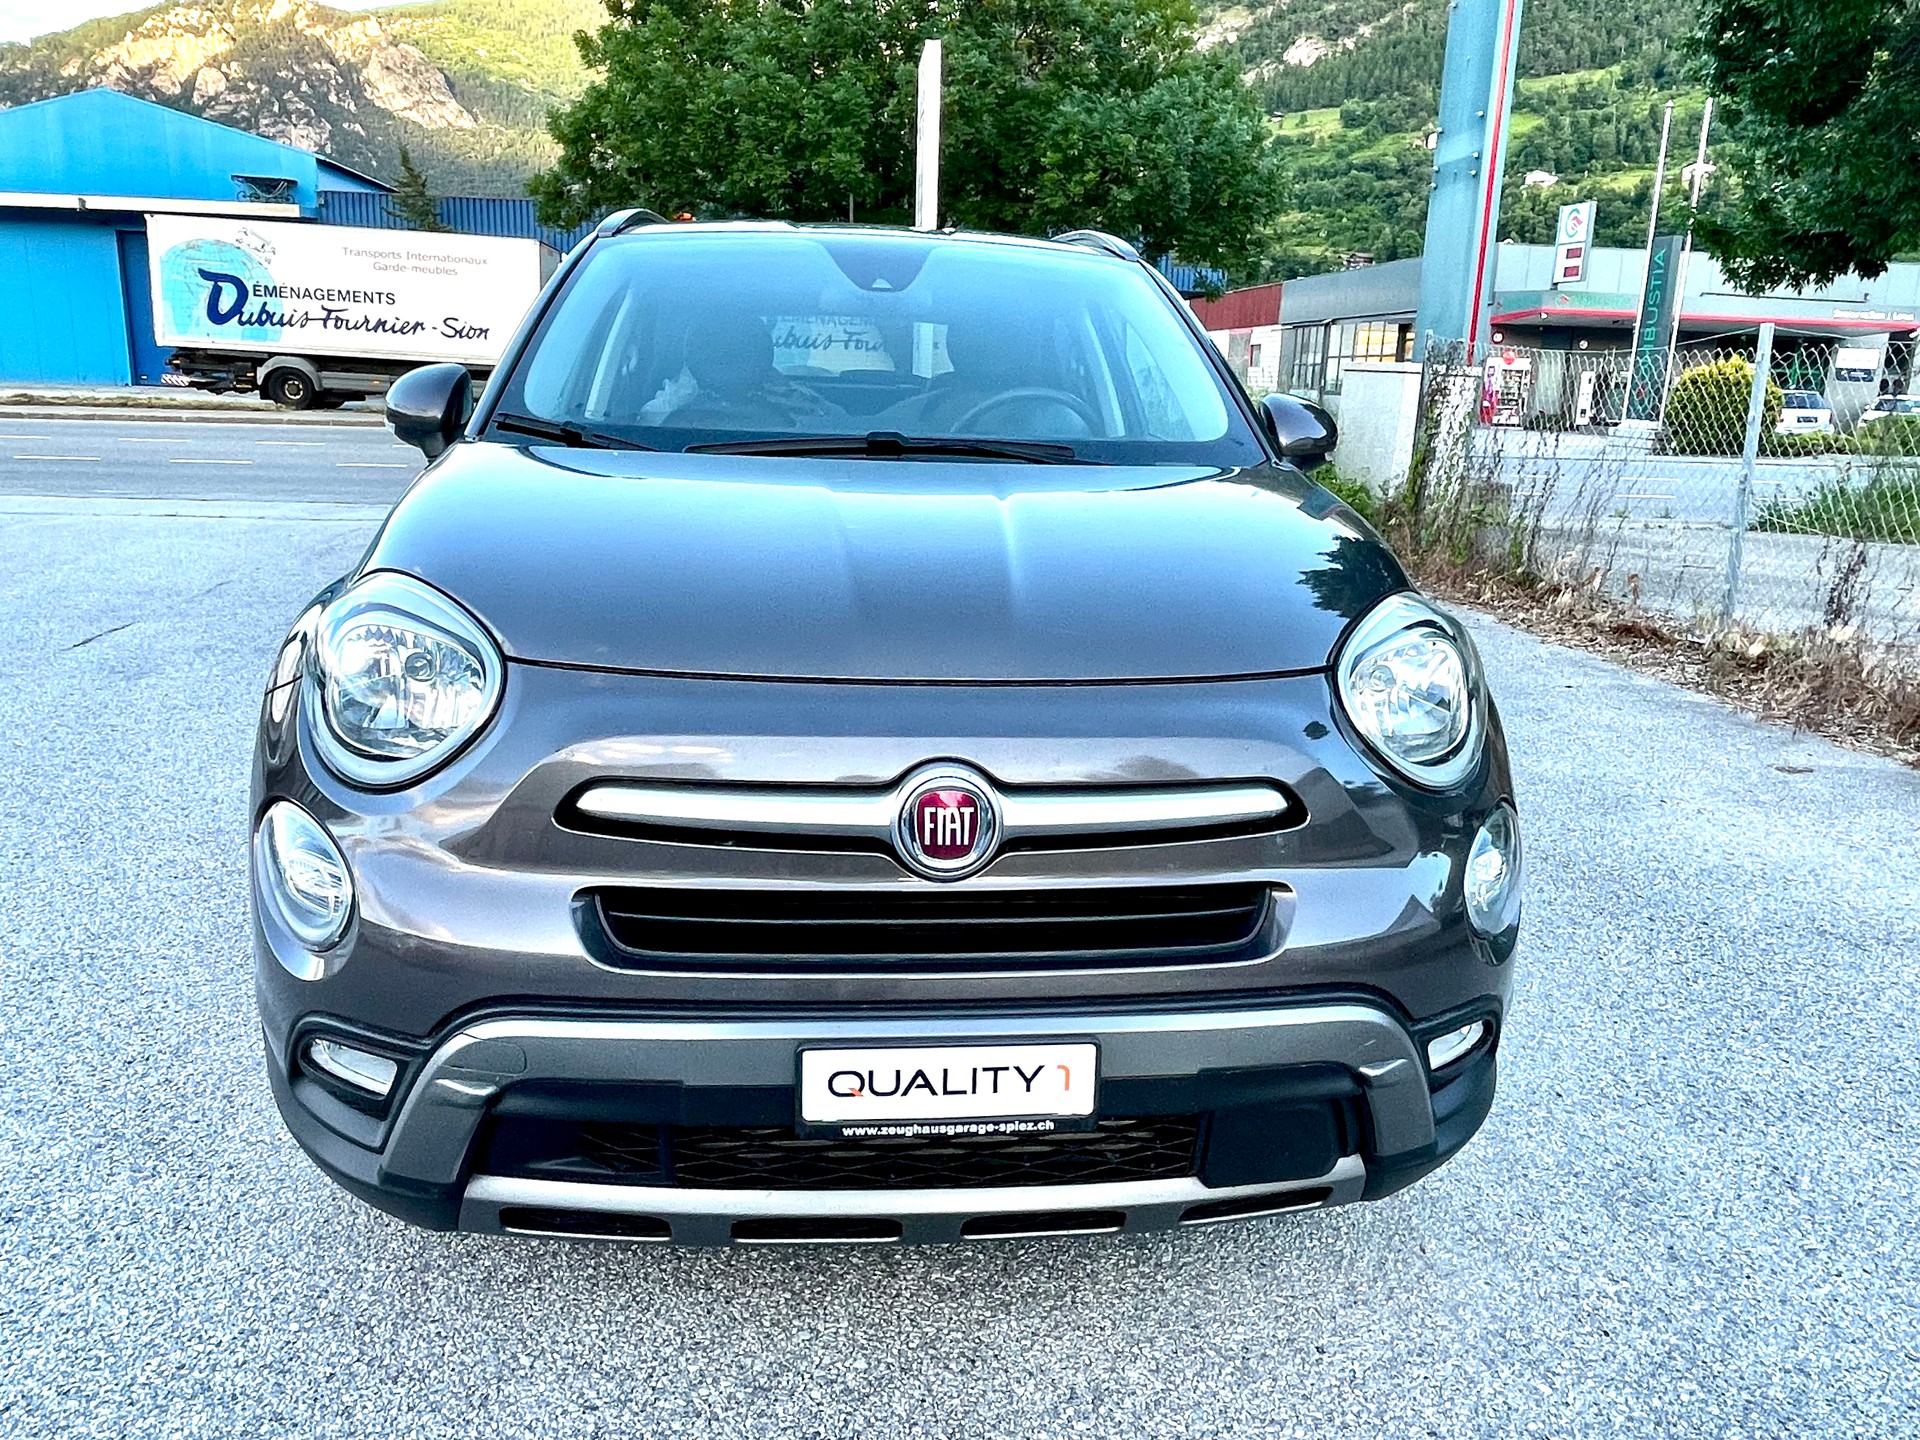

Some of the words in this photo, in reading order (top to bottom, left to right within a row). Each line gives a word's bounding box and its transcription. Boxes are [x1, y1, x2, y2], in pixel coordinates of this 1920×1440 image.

[343, 247, 403, 261] Transports
[406, 251, 488, 266] Internationaux
[373, 262, 458, 277] Garde-meubles
[440, 317, 490, 341] Sion
[923, 806, 975, 846] FIAT
[827, 1065, 1046, 1098] QUALITY
[1056, 1064, 1070, 1092] 1
[841, 1119, 1055, 1138] www.zeughausgarage-spiez.ch
